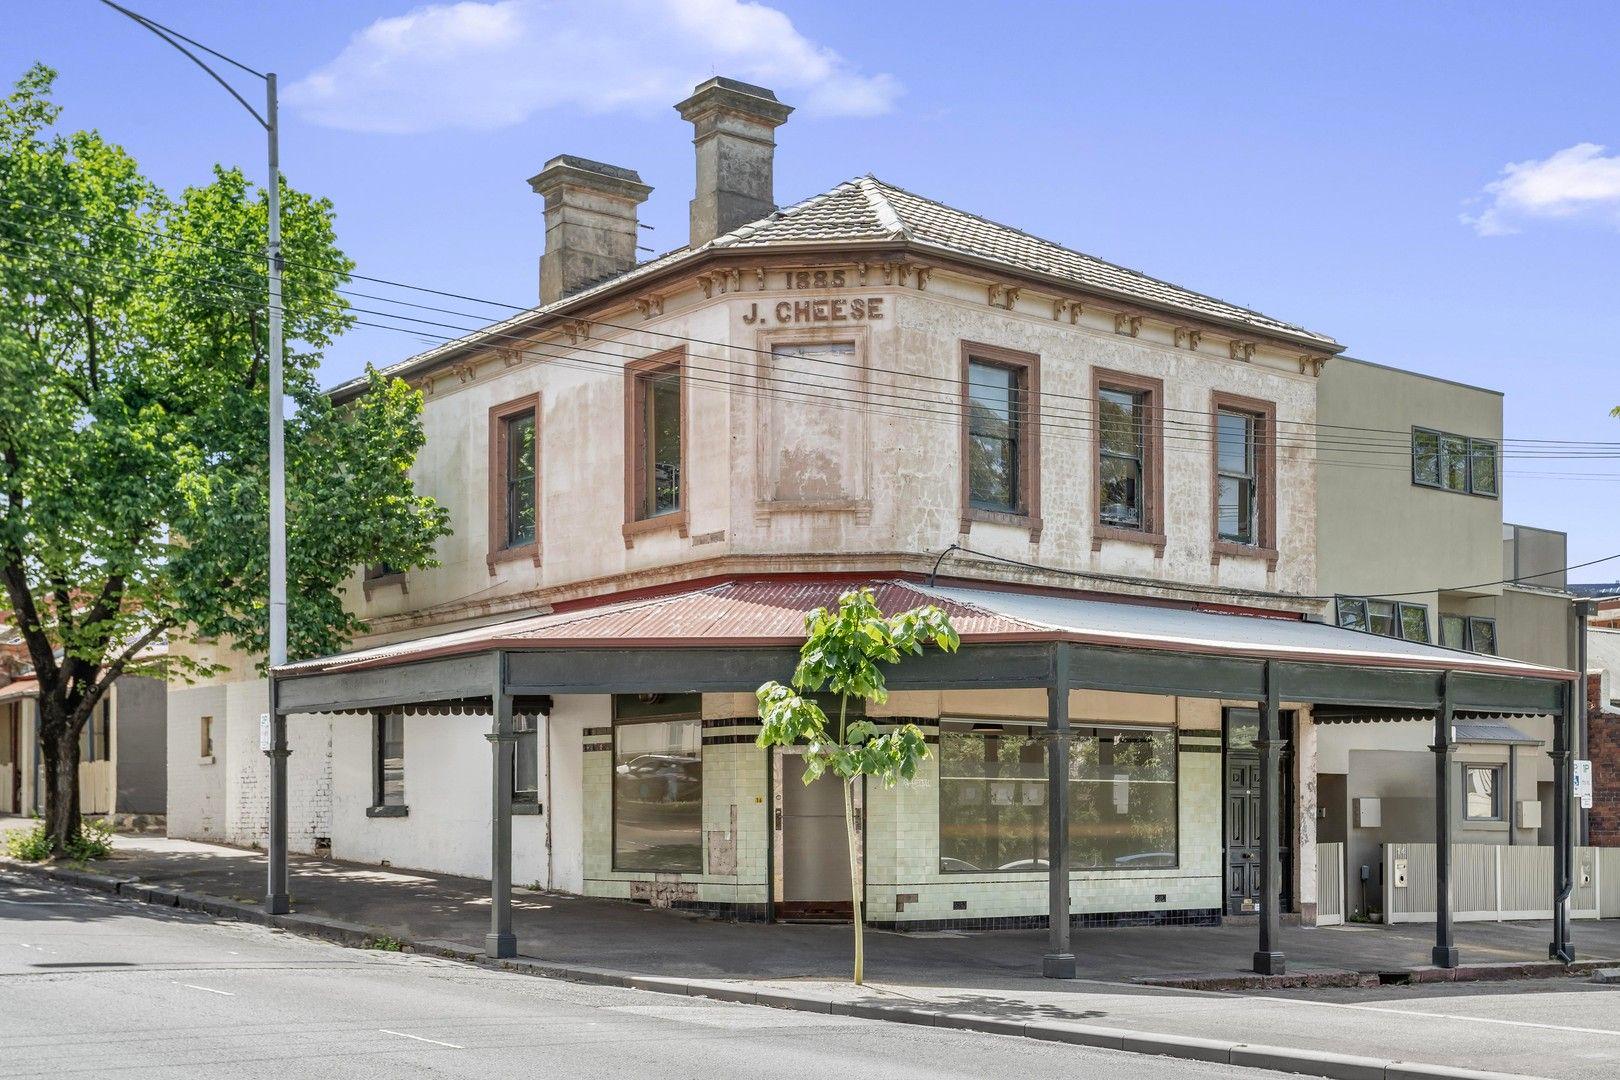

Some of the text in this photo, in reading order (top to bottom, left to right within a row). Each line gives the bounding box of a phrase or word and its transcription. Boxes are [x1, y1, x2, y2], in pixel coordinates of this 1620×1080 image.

[786, 270, 846, 290] 1885
[743, 297, 884, 324] J. CHEESE
